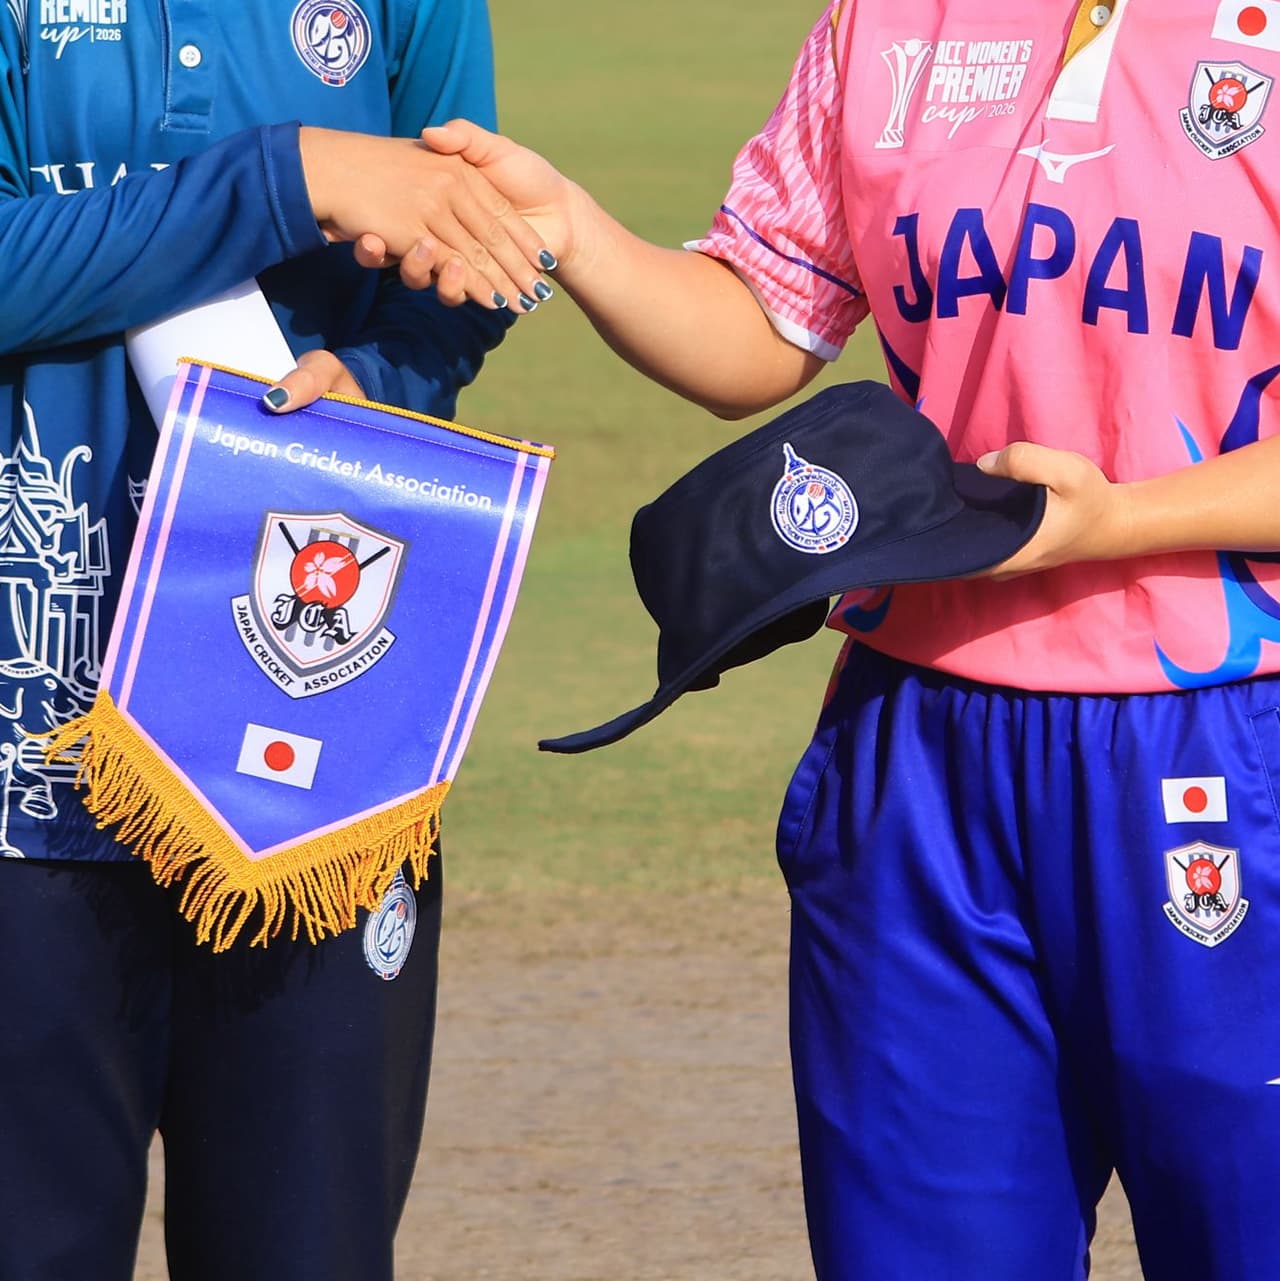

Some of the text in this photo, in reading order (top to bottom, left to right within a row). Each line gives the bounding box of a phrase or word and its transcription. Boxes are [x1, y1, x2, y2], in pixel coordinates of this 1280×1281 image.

[40, 25, 121, 60] up 2026
[934, 39, 1033, 65] ACC WOMEN'S
[925, 64, 1027, 103] PREMIER
[921, 101, 1016, 140] cup 2026
[892, 203, 1264, 351] JAPAN
[208, 424, 492, 511] Japan Cricket Association
[271, 593, 359, 645] JCA
[236, 604, 389, 692] JAPAN CRICKET ASSOCIATION
